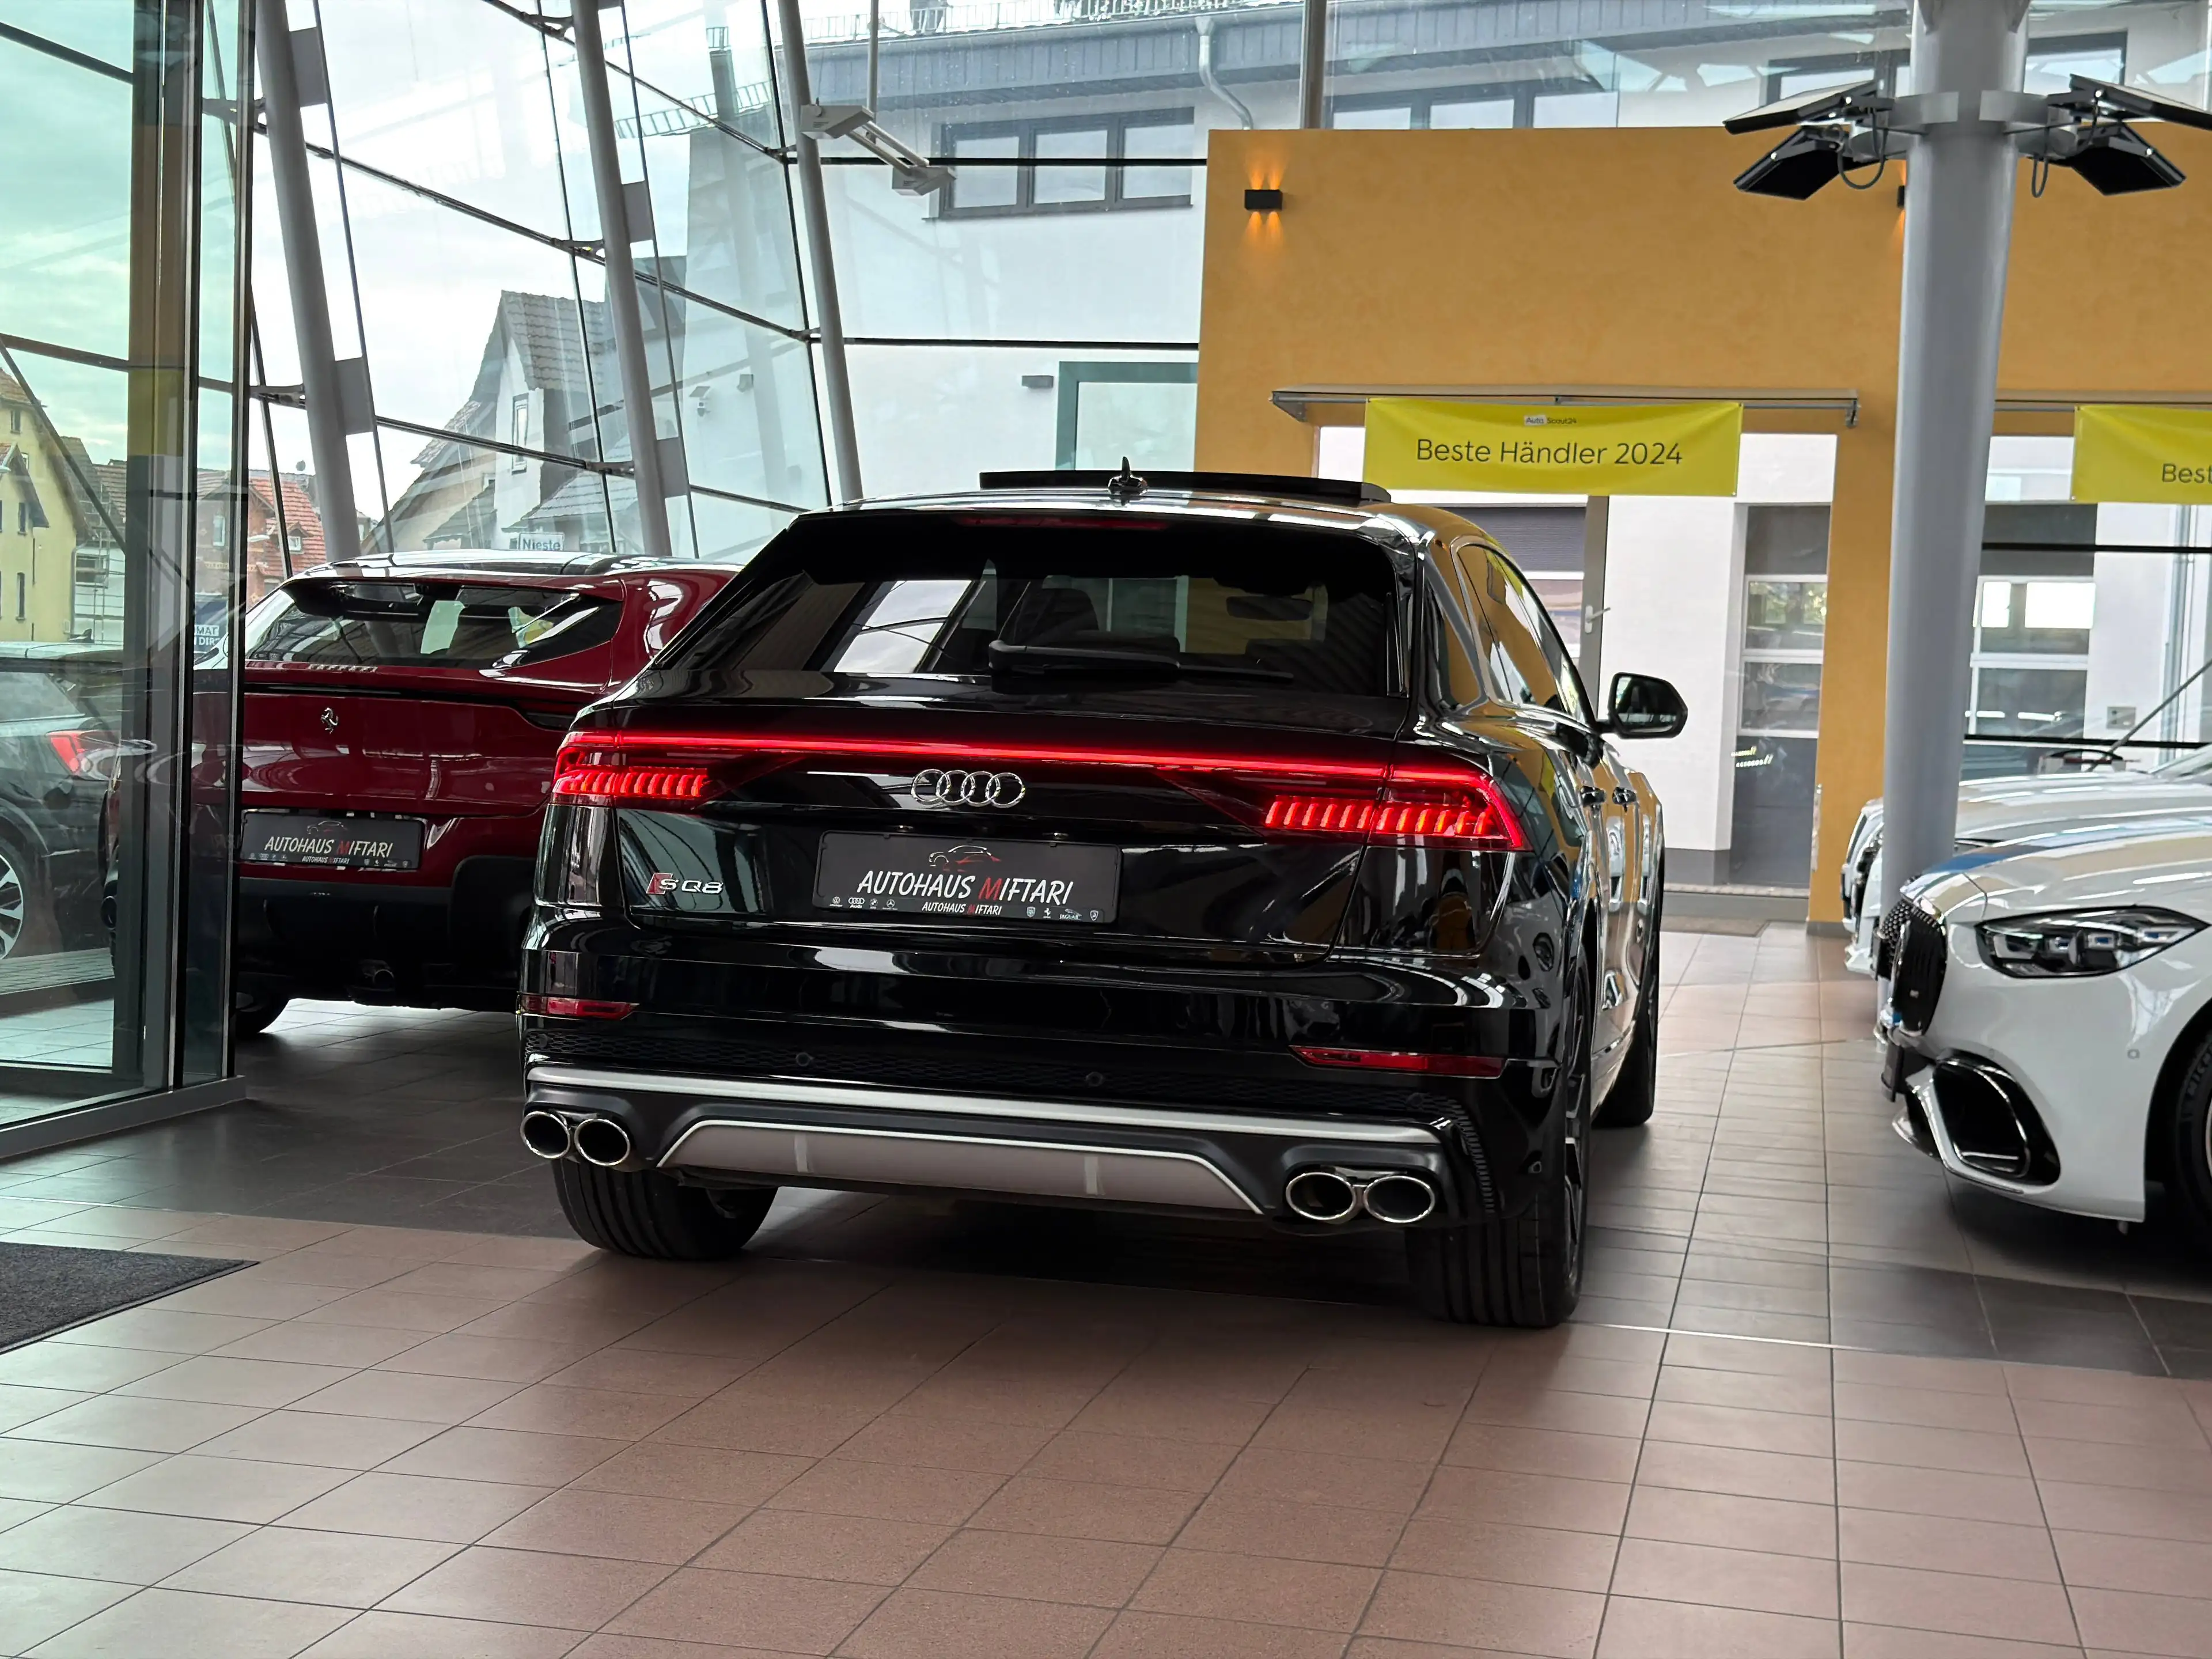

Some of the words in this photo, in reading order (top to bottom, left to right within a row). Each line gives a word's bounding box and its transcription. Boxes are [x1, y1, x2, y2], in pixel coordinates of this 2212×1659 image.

[1525, 416, 1544, 424] Auto
[1417, 439, 1491, 462] Beste
[1499, 441, 1607, 464] Händler
[1613, 442, 1684, 465] 2024
[522, 538, 561, 551] Nieste
[264, 836, 335, 854] AUTOHAUS
[336, 840, 393, 858] MIFTARI
[302, 856, 328, 864] AUTOHAUS
[658, 878, 724, 894] SQ8
[857, 870, 975, 899] AUTOHAUS
[978, 876, 1074, 906] MIFTARI
[922, 902, 966, 913] AUTOHAUS
[967, 904, 1003, 915] MIFTARI
